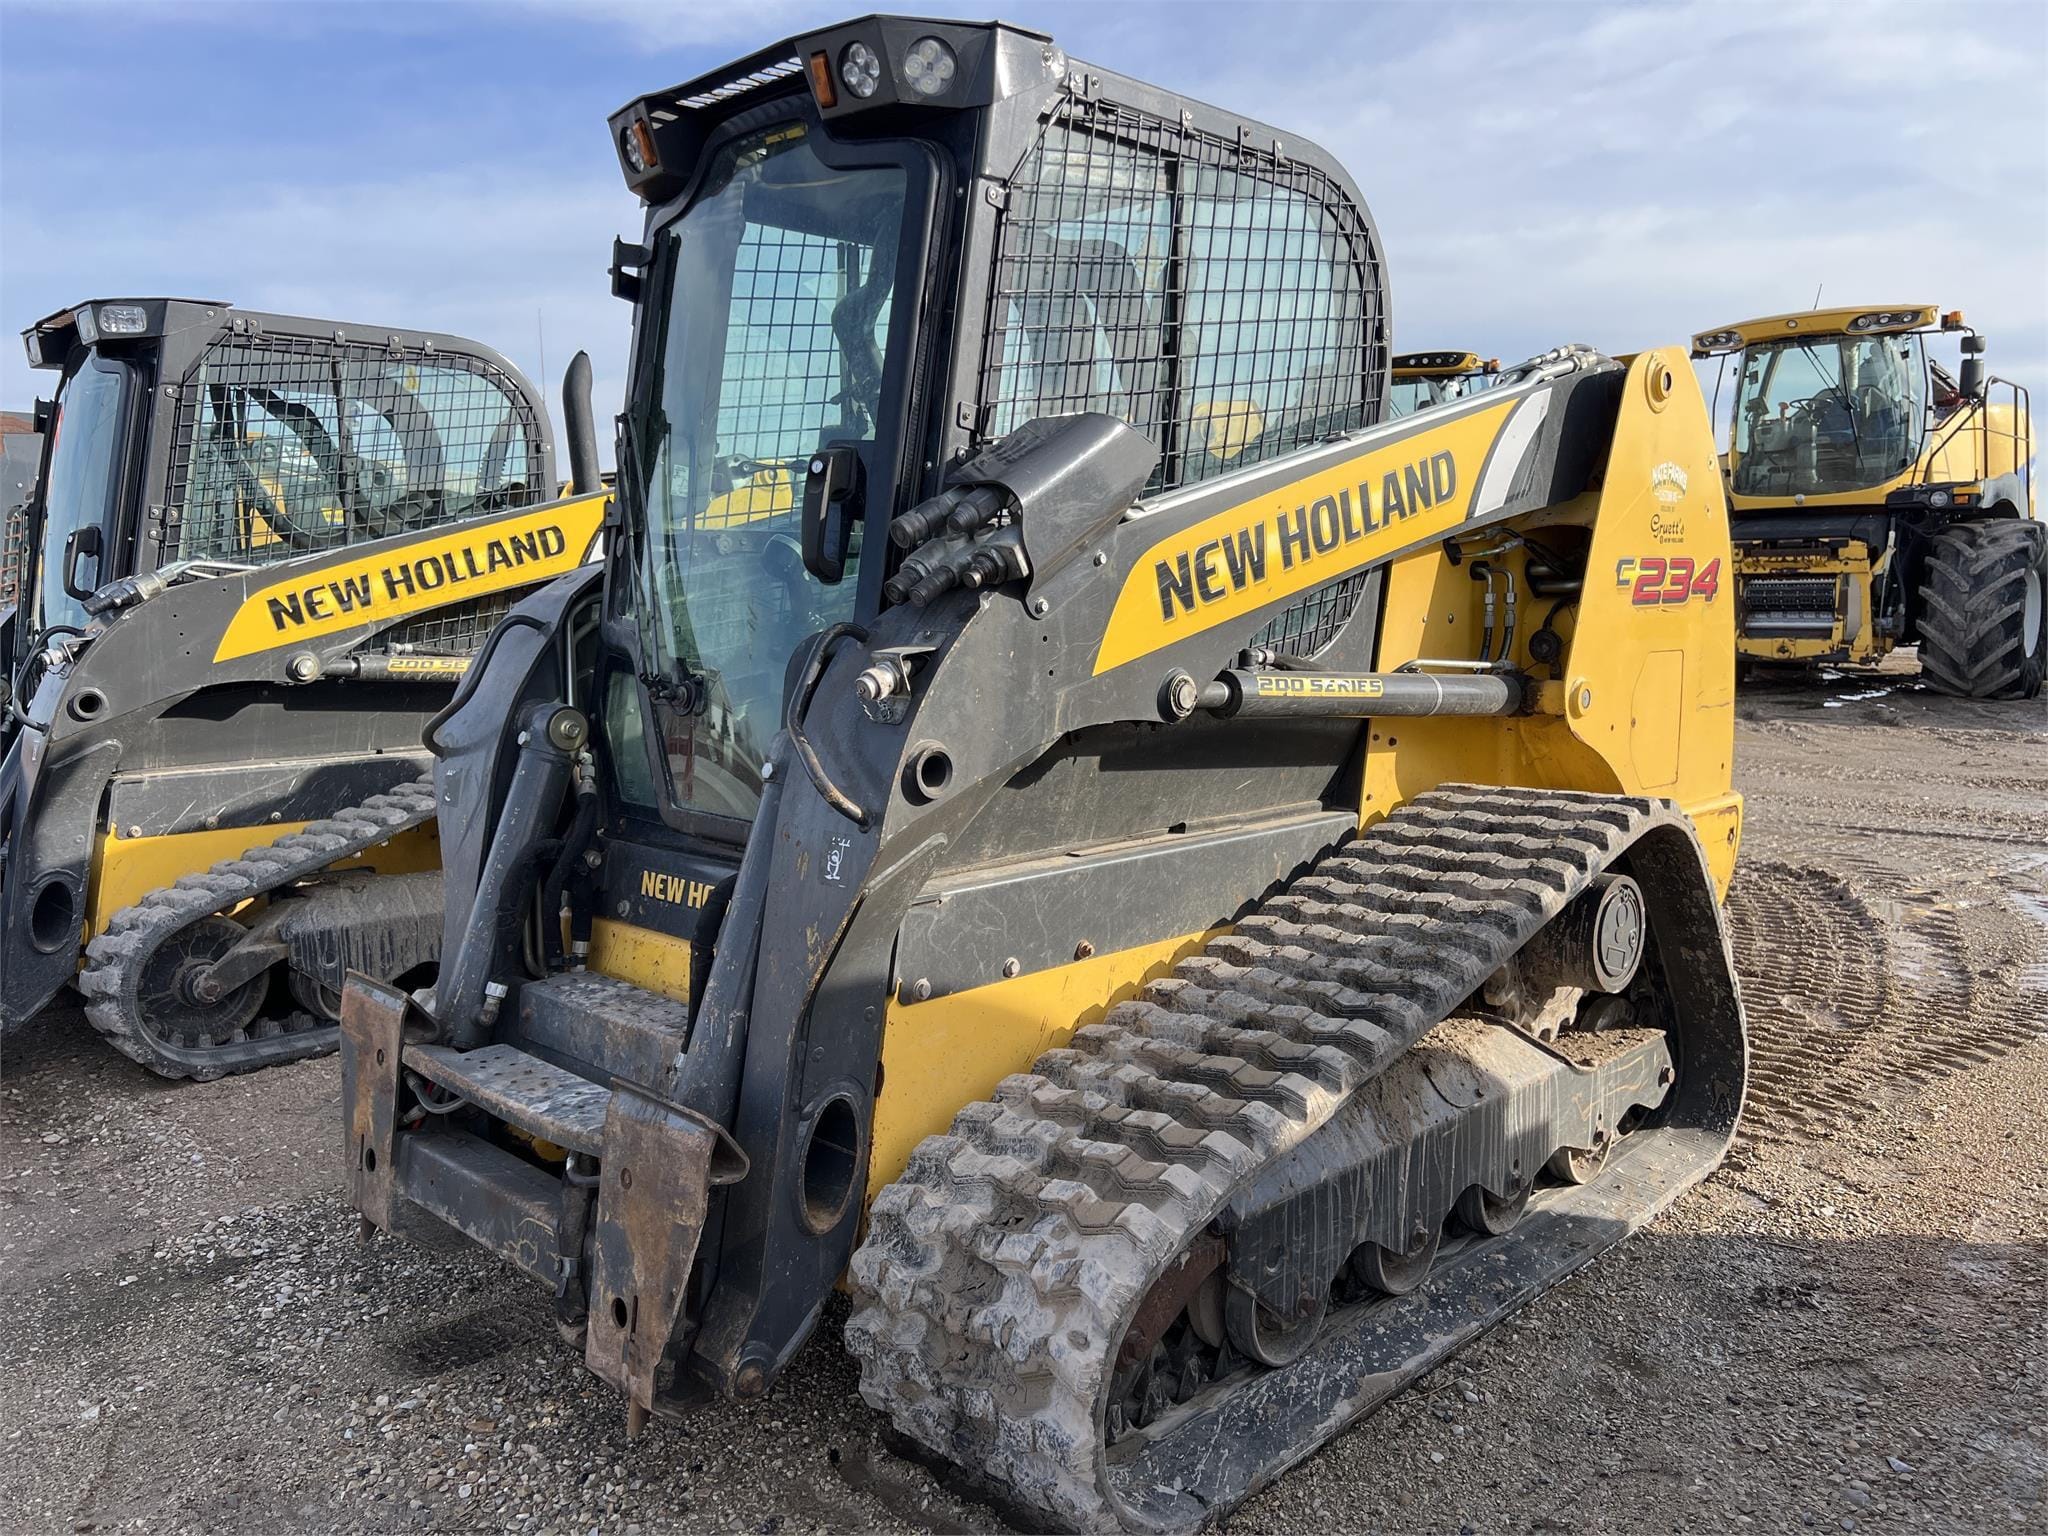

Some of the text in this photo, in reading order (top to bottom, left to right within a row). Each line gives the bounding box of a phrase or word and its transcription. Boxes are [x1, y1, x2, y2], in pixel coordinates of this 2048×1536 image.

[1155, 449, 1457, 622] NEW HOLLAND
[1650, 513, 1684, 538] Gruett's
[266, 525, 566, 631] NEW HOLLAND
[389, 660, 434, 669] 200
[1259, 678, 1381, 692] 200 SERIES
[641, 869, 686, 904] NEW
